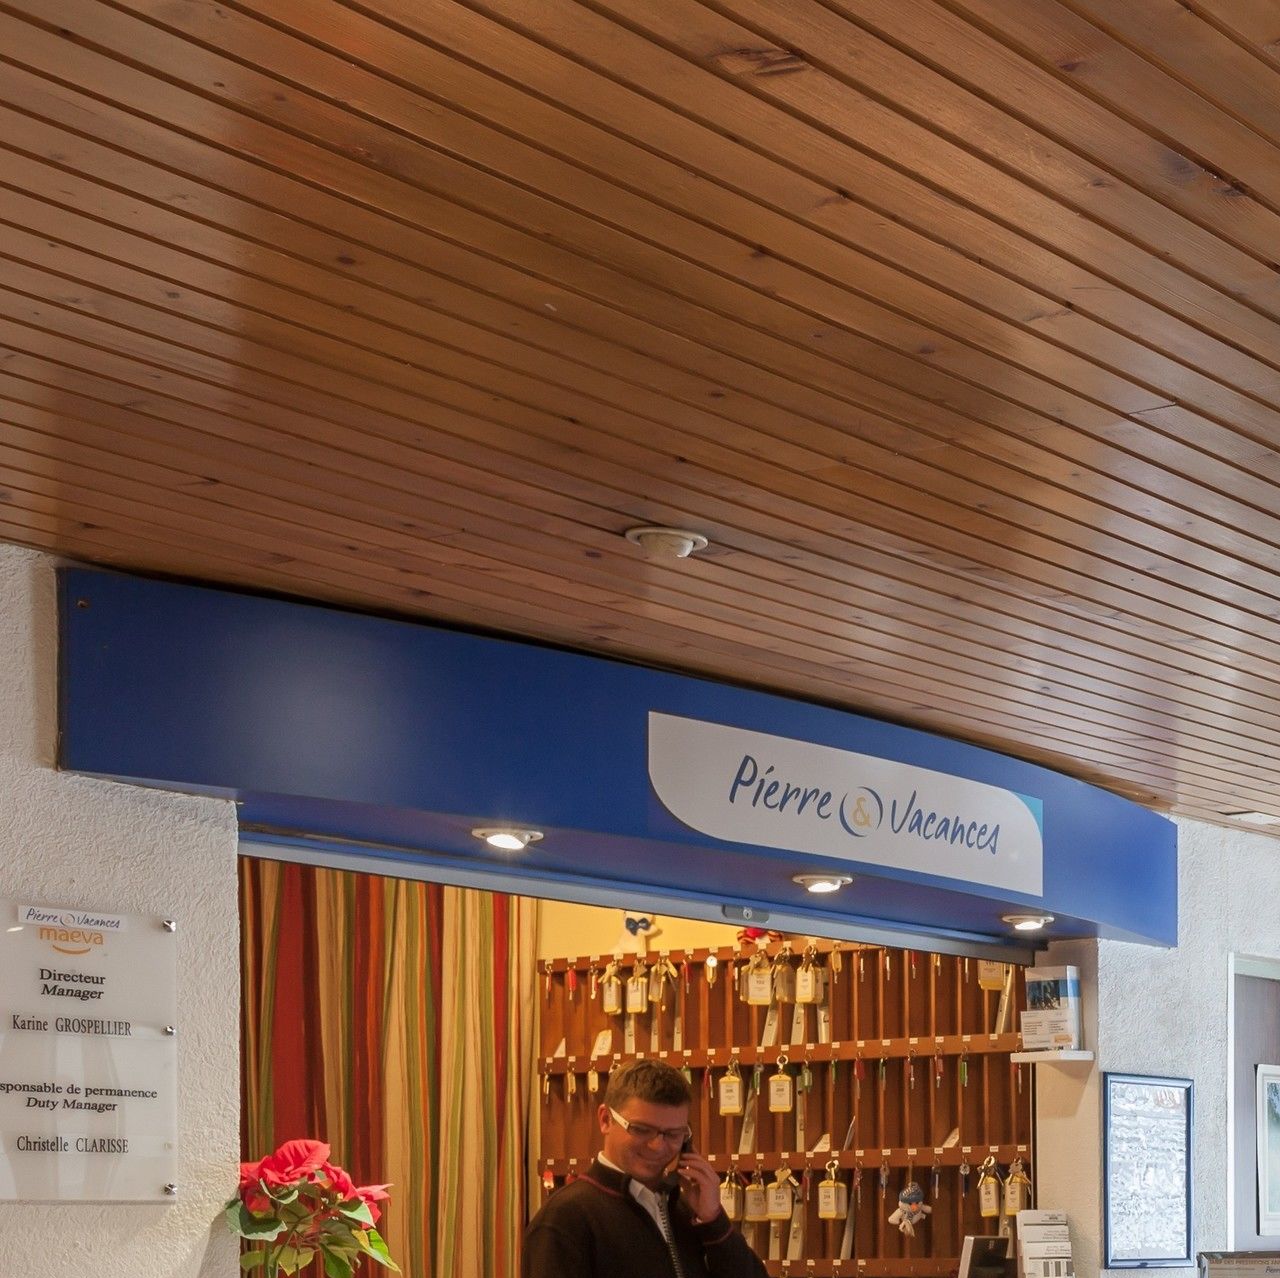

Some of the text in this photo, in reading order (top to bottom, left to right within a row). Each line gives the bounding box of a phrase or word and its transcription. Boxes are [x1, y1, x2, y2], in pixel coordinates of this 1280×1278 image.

[728, 754, 833, 820] Pierre
[890, 789, 1000, 855] Vacances
[26, 907, 58, 923] Pierre
[77, 914, 120, 929] Vacances
[39, 927, 104, 945] maeva
[39, 968, 106, 985] Directeur
[41, 983, 104, 1001] Manager
[12, 1014, 132, 1036] Karine GROSPELLIER
[0, 1083, 158, 1098] sponsable de permanence
[26, 1097, 118, 1113] Duty Manager
[17, 1136, 129, 1153] Christelle CLARISSE
